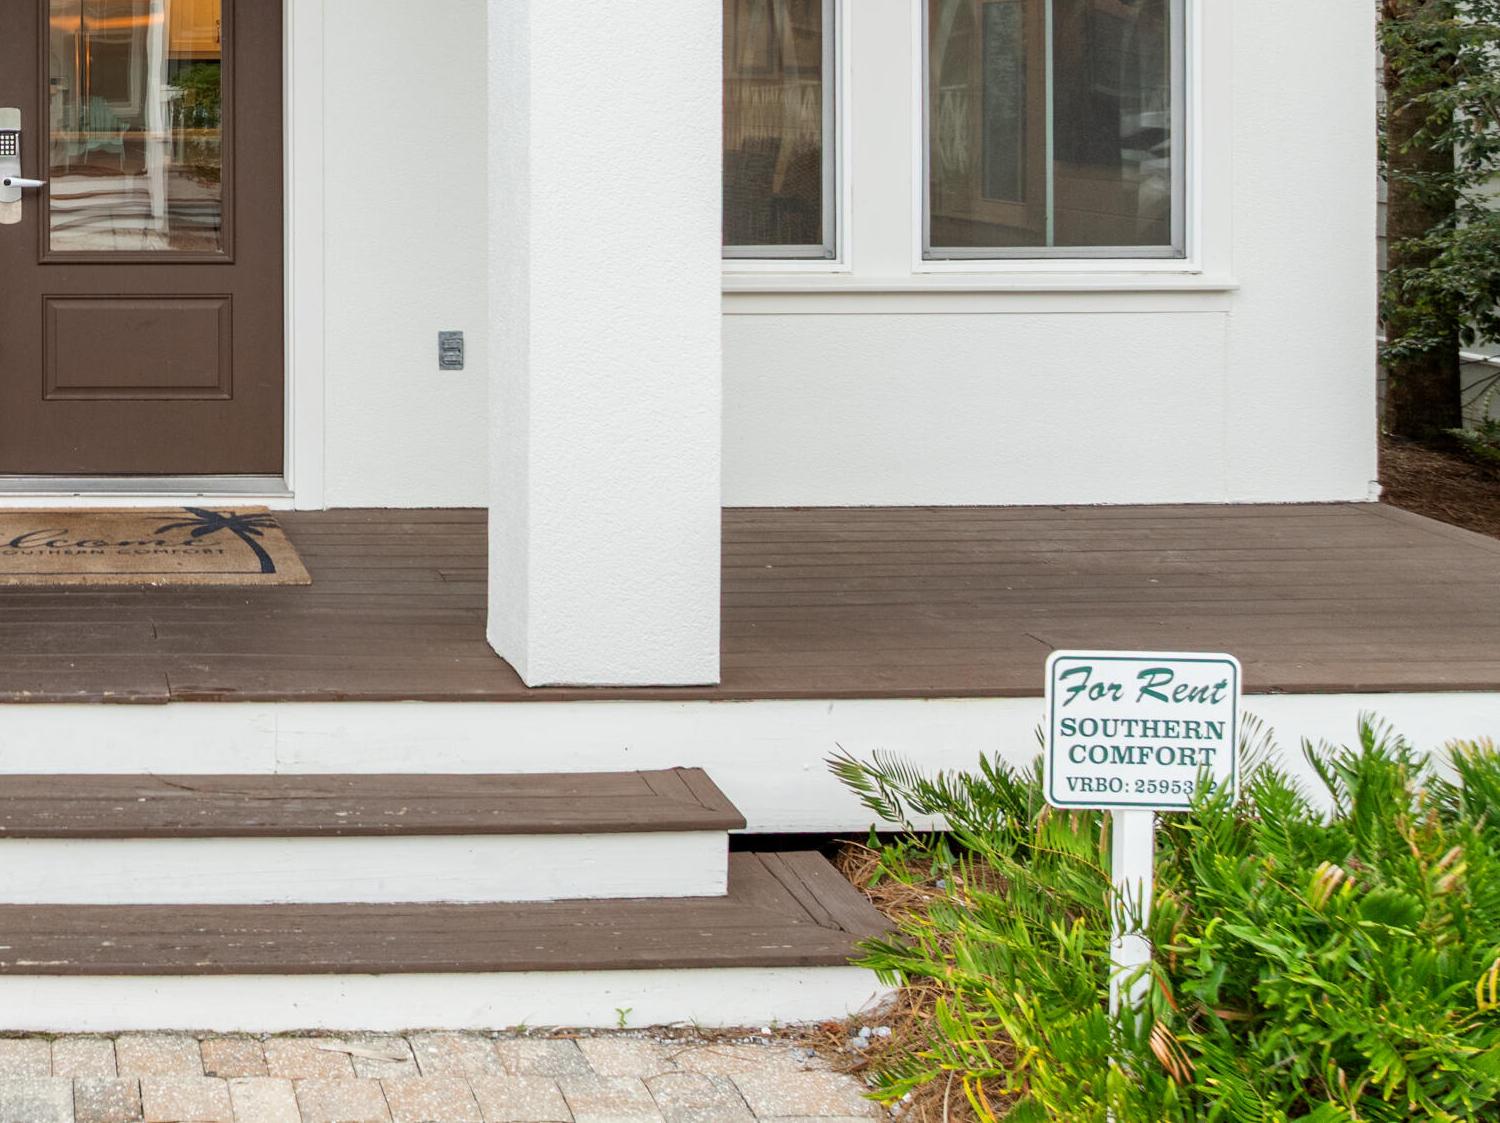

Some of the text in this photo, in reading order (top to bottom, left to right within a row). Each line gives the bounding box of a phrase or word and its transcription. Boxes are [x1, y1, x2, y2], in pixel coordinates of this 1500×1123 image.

[1058, 665, 1228, 707] For Rent
[1060, 717, 1226, 740] SOUTHERN
[1068, 744, 1217, 767] COMFORT
[1066, 776, 1218, 795] VRBO: 259532
